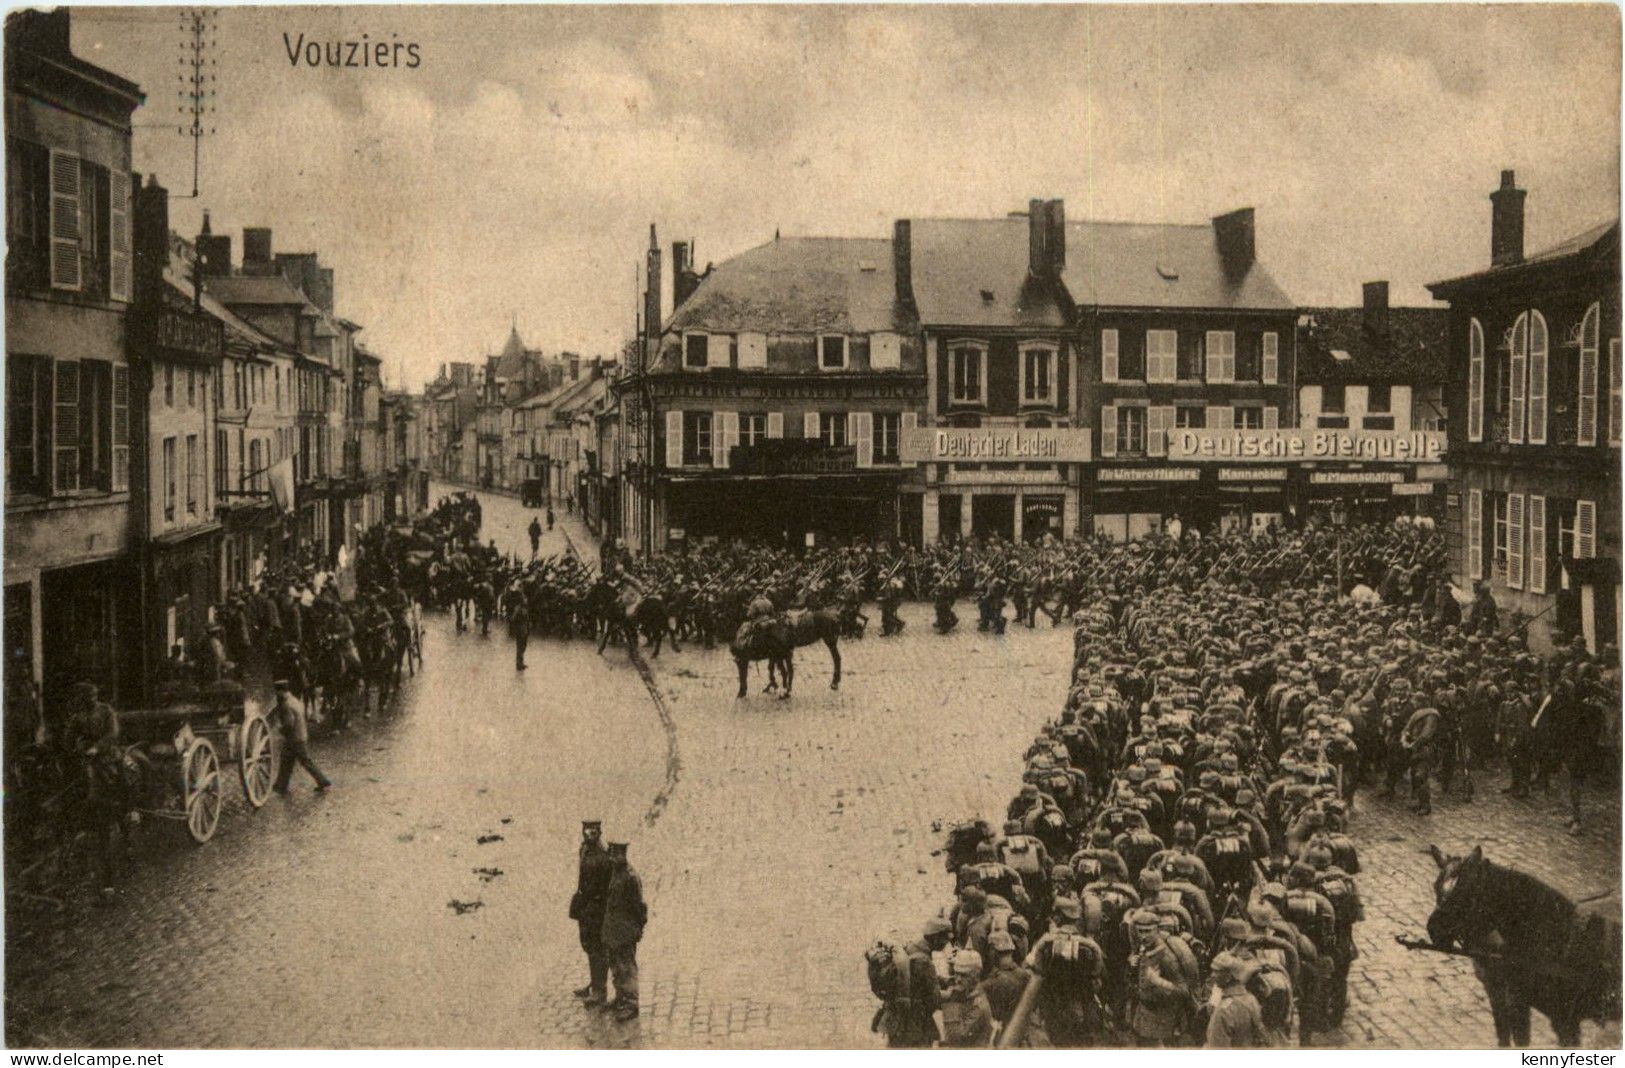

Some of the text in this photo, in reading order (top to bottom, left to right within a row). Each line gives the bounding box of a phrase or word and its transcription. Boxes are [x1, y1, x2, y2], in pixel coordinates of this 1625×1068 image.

[936, 430, 1011, 457] Deutscher
[1013, 430, 1057, 457] Laden
[1180, 431, 1441, 459] Deutsche Bierquelle
